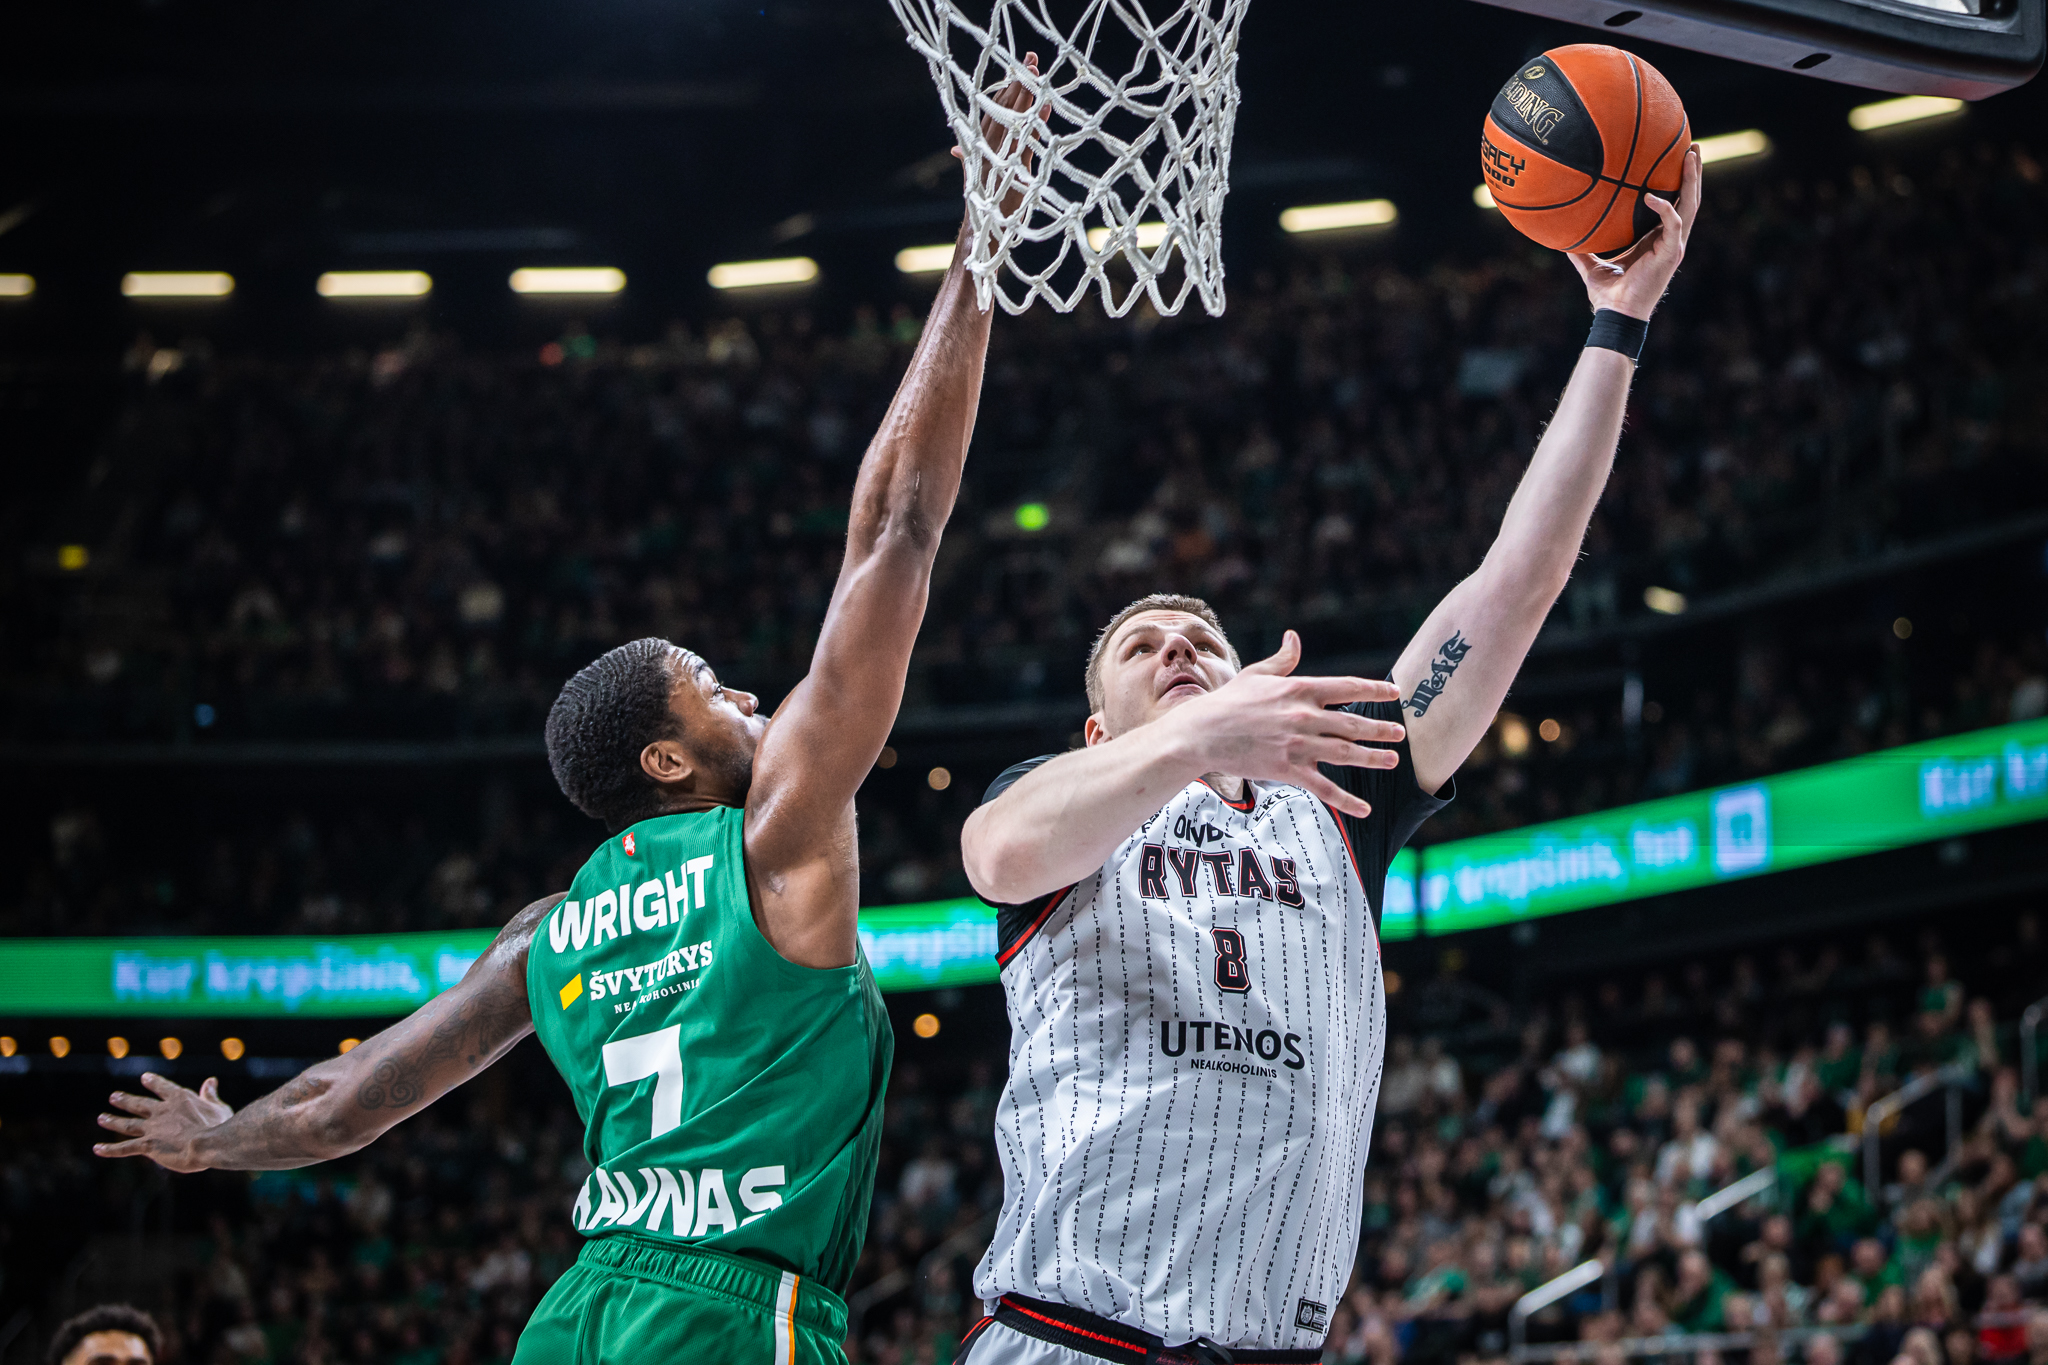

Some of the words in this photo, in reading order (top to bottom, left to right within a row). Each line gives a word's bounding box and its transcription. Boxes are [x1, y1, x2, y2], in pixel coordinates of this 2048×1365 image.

[1501, 75, 1565, 142] DING
[548, 854, 714, 954] WRIGHT
[1138, 842, 1306, 911] RYTAS
[589, 940, 713, 1001] ŠVYTURYS
[1210, 926, 1252, 994] 8
[614, 978, 700, 1014] NEAKOHOLINIS
[1161, 1020, 1306, 1070] UTENOS
[1190, 1058, 1278, 1079] NEALKOHOLINIS
[602, 1023, 684, 1139] 7
[572, 1165, 786, 1237] KAUNAS
